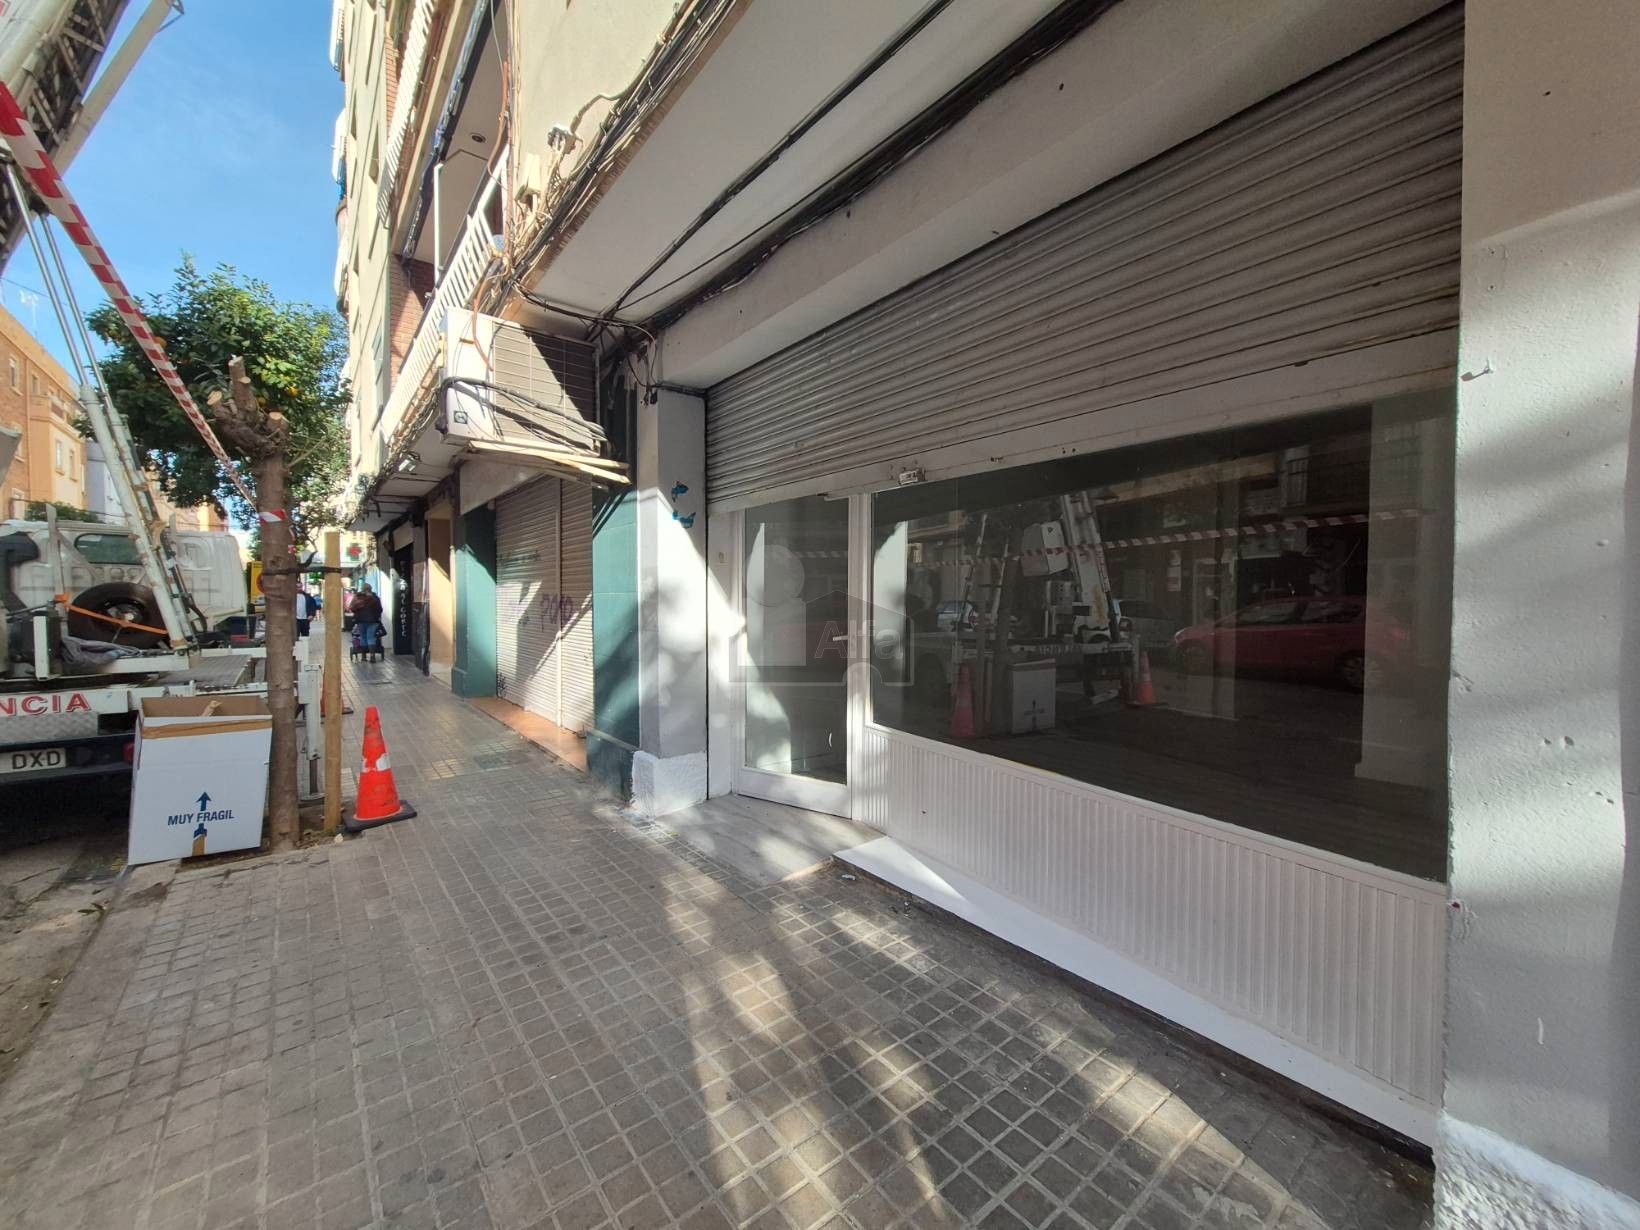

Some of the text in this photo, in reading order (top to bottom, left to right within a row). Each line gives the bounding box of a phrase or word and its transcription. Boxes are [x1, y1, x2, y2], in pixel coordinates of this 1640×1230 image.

[12, 751, 60, 769] DXD
[168, 809, 234, 825] MUY FRAGIL
